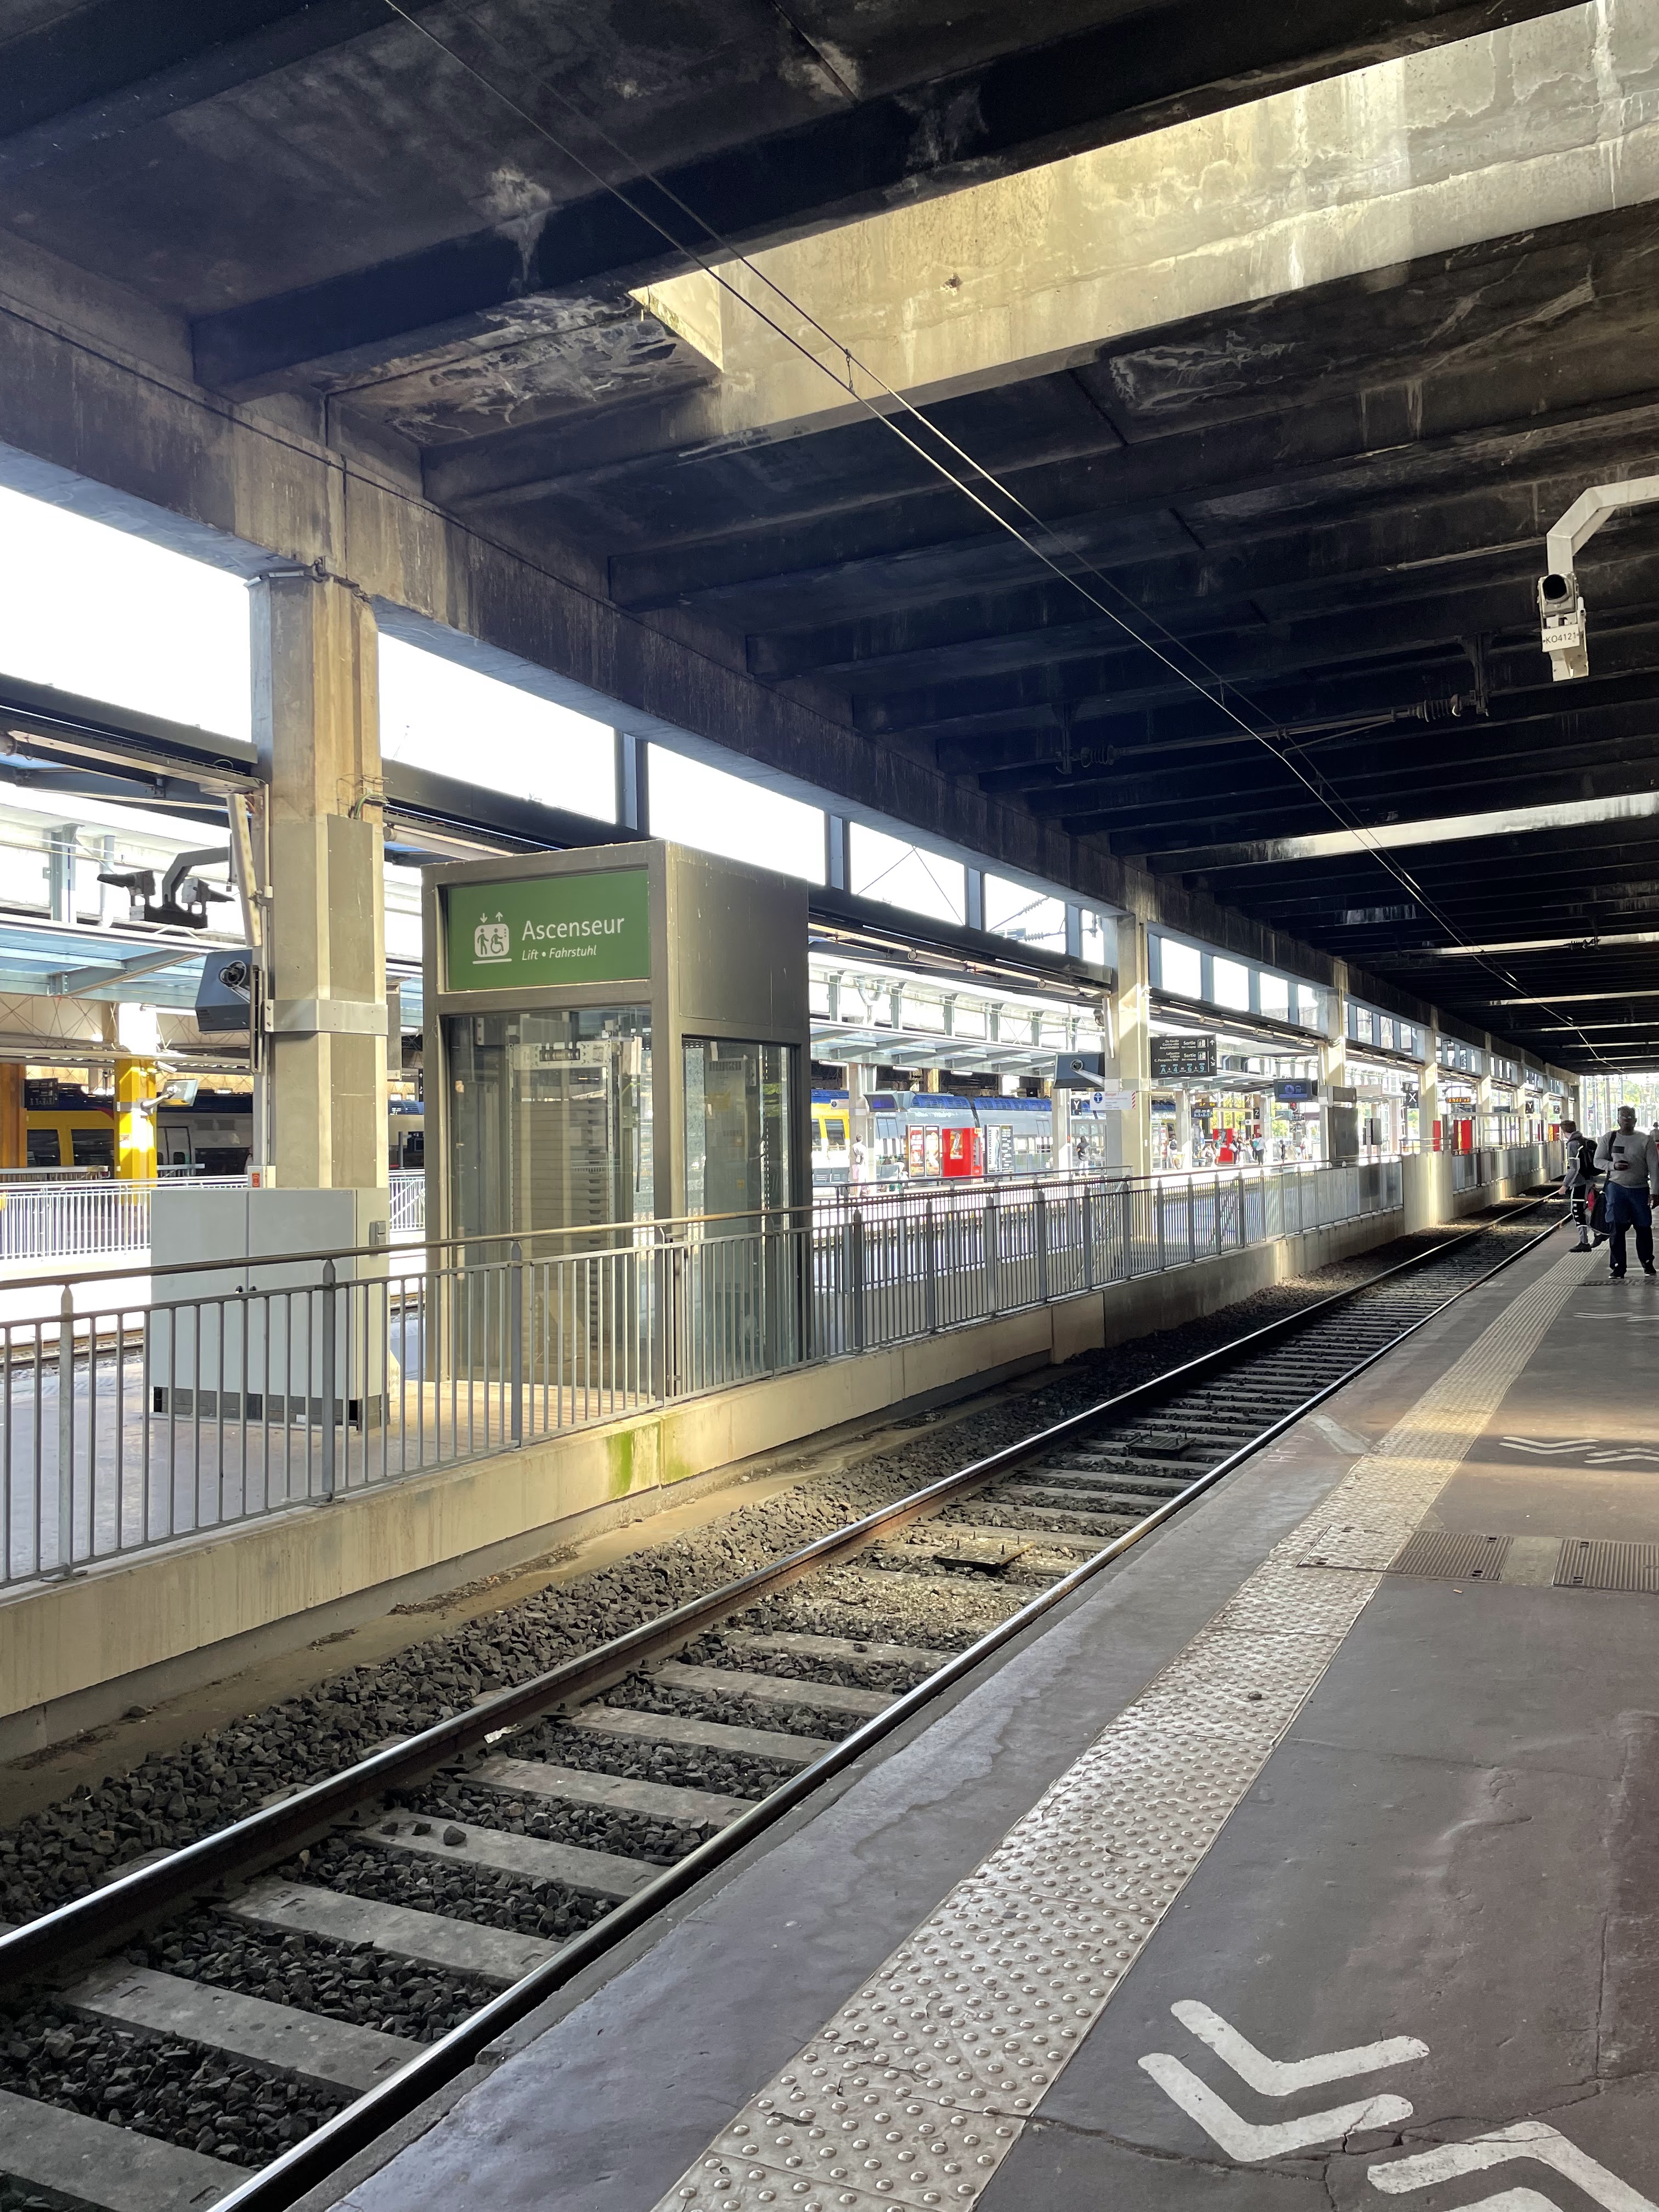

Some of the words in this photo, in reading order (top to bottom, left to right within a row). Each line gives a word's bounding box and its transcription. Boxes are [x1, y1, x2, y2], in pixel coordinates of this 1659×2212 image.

[522, 918, 624, 940] Ascenseur
[522, 949, 538, 961] Lift
[549, 945, 597, 958] Fahrstuhl
[1409, 1093, 1417, 1102] X
[1074, 1101, 1080, 1109] Y
